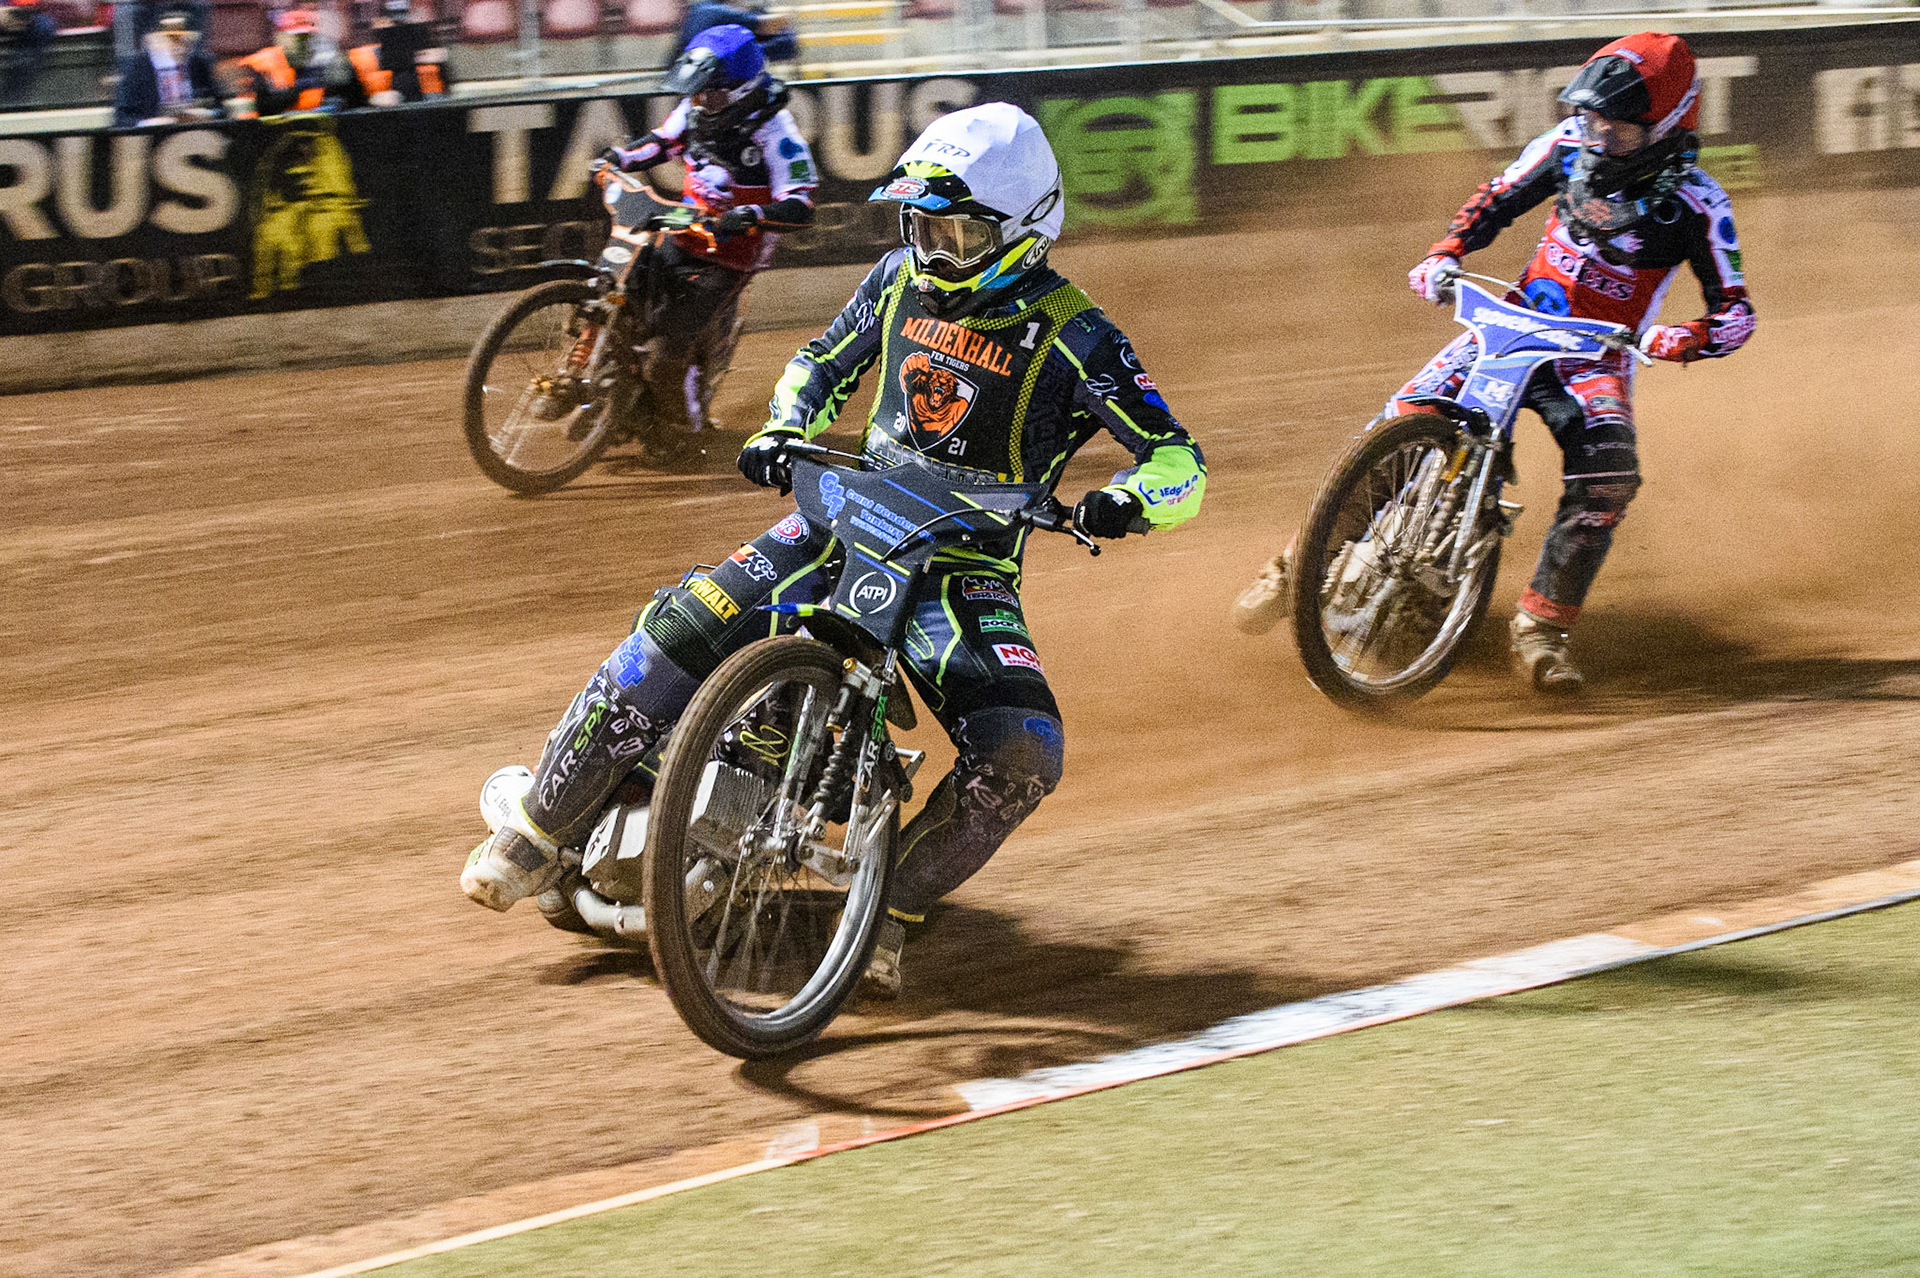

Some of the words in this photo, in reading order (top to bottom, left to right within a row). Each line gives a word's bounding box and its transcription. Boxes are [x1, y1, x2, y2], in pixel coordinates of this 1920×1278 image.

[900, 316, 1013, 377] MILDENHALL
[1019, 322, 1040, 350] 1
[931, 350, 945, 362] FEN
[945, 356, 970, 371] TIGERS
[893, 411, 906, 432] 20
[948, 437, 968, 456] 21
[873, 503, 937, 543] Henderon
[690, 578, 741, 622] WALT
[855, 584, 889, 601] ATPI
